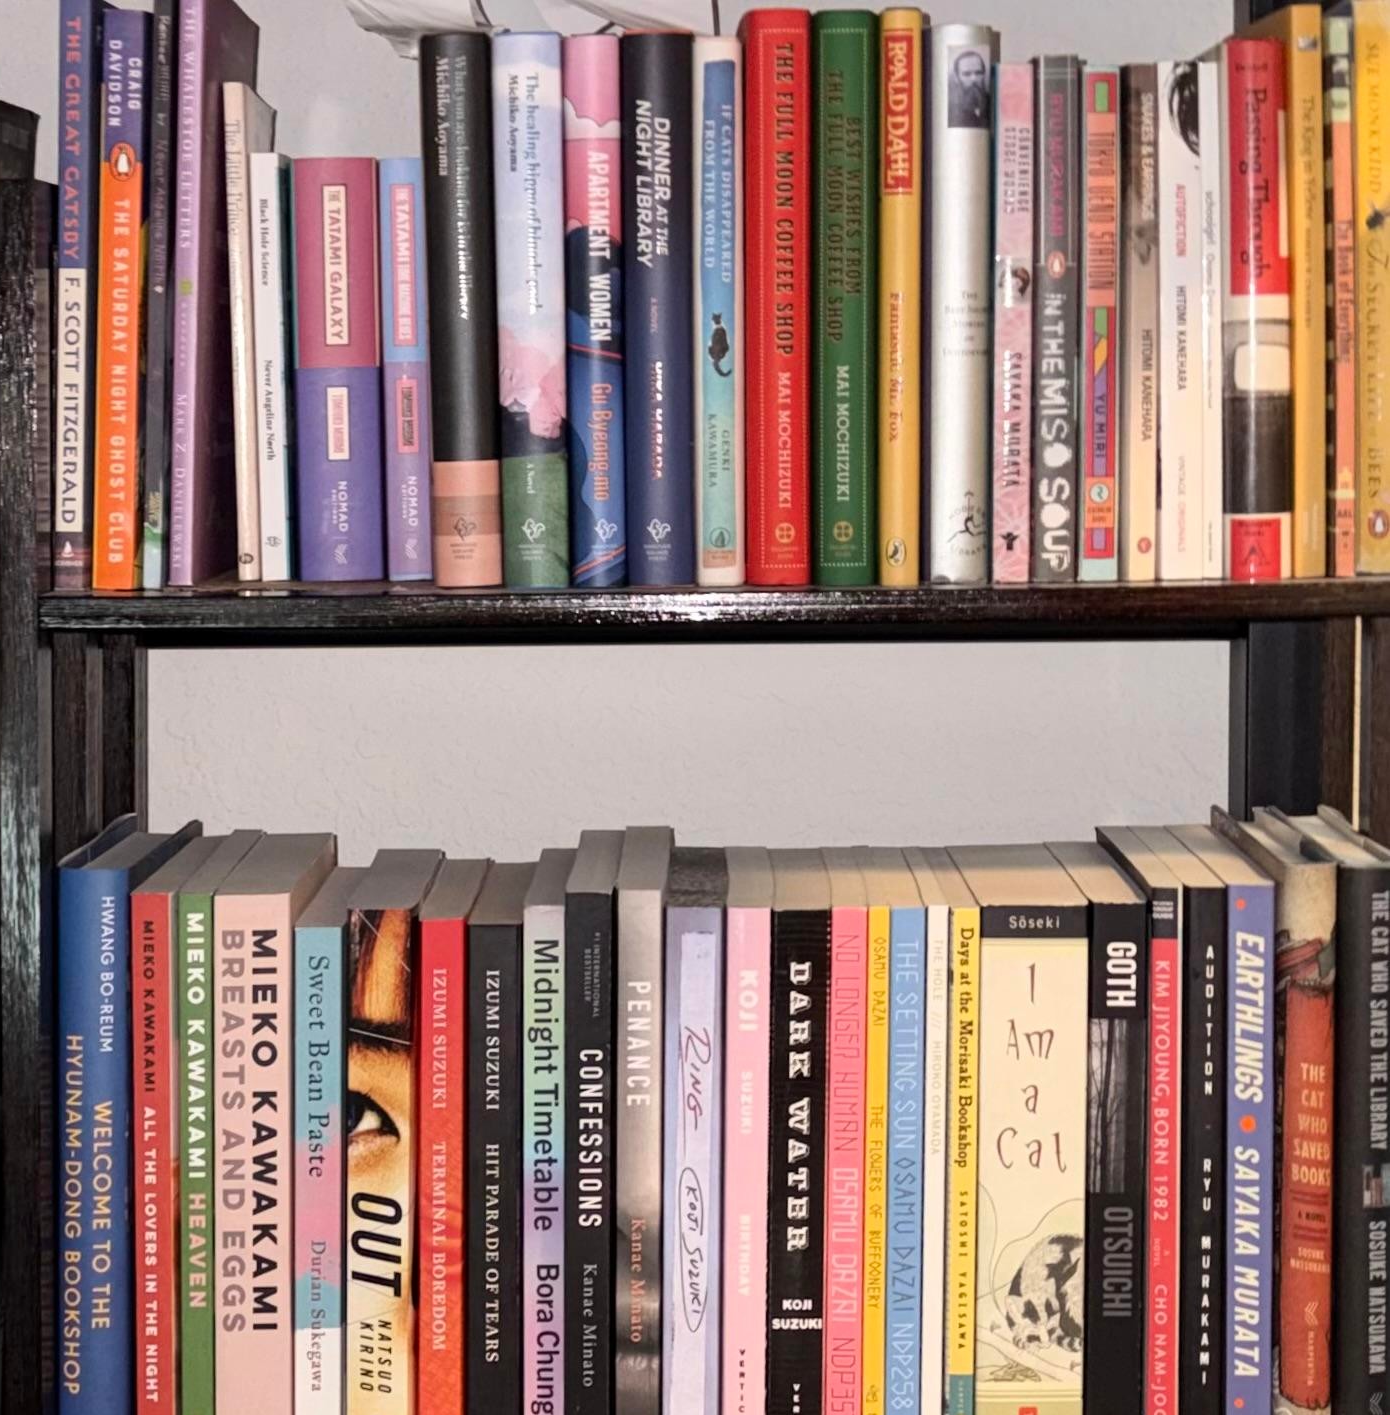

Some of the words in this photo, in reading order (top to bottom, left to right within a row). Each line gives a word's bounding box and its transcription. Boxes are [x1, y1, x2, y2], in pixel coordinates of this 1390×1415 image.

[776, 43, 793, 82] THE
[886, 40, 908, 105] ROALD
[636, 100, 652, 164] NIGHT
[776, 90, 793, 141] FULL
[885, 111, 910, 188] DAHL
[1238, 88, 1268, 175] Passing
[655, 117, 671, 199] DINNER
[776, 151, 793, 210] MOON
[587, 151, 610, 259] APARTMENT
[635, 168, 653, 266] LIBRARY
[656, 221, 669, 256] THE
[1239, 178, 1270, 278] Through
[776, 220, 793, 300] COFFEE
[64, 301, 81, 373] SCOTT
[588, 273, 611, 341] WOMEN
[776, 304, 793, 354] SHOP
[1178, 286, 1187, 326] HITOMI
[1177, 331, 1187, 391] KANEHARA
[61, 383, 80, 525] FITZGERALD
[252, 929, 278, 1067] MIEKO
[308, 955, 330, 1031] Sweet
[528, 939, 559, 1075] Midnight
[1107, 942, 1135, 1007] GOTH
[221, 930, 245, 1110] BREASTS
[627, 981, 652, 1107] PENANCE
[789, 961, 811, 1078] DARK
[1234, 932, 1264, 1103] EARTHLINGS
[309, 1041, 330, 1106] Bean
[222, 1130, 245, 1210] AND
[308, 1112, 329, 1178] Paste
[531, 1082, 560, 1231] Timetable
[579, 1048, 603, 1228] CONFESSIONS
[788, 1099, 811, 1253] WATER
[252, 1091, 278, 1330] KAWAKAMI
[1235, 1147, 1258, 1254] SAYAKA
[222, 1231, 245, 1333] EGGS
[351, 1191, 402, 1296] OUT
[536, 1264, 560, 1320] Bora
[771, 1318, 822, 1330] SUZUKI
[782, 1299, 812, 1311] KOJI
[1233, 1269, 1258, 1378] MURATA
[359, 1320, 373, 1394] KIRINO
[378, 1320, 391, 1394] NATSUO
[531, 1328, 560, 1415] Chung
